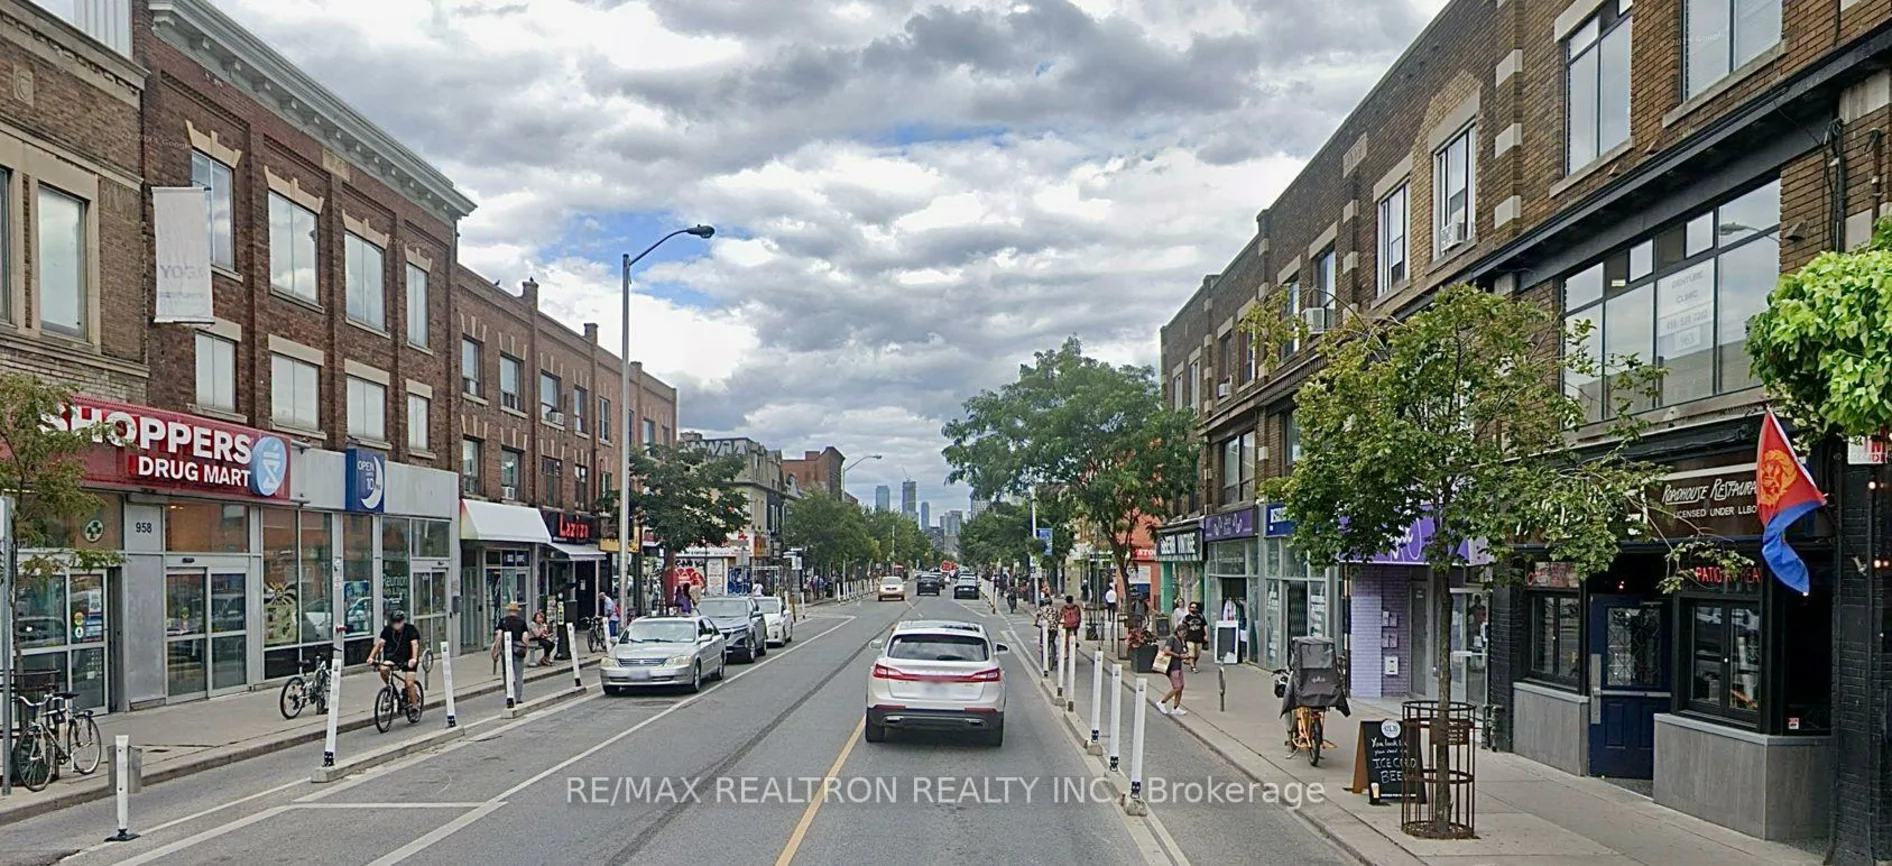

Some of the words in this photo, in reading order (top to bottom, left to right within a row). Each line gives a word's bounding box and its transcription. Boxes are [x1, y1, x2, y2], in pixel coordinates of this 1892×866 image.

[38, 401, 252, 465] SHOPPERS
[137, 455, 199, 482] DRUG
[203, 465, 252, 488] MART
[1661, 484, 1709, 506] ROADHOUSE
[1710, 506, 1735, 517] UNDER
[135, 521, 153, 534] 958
